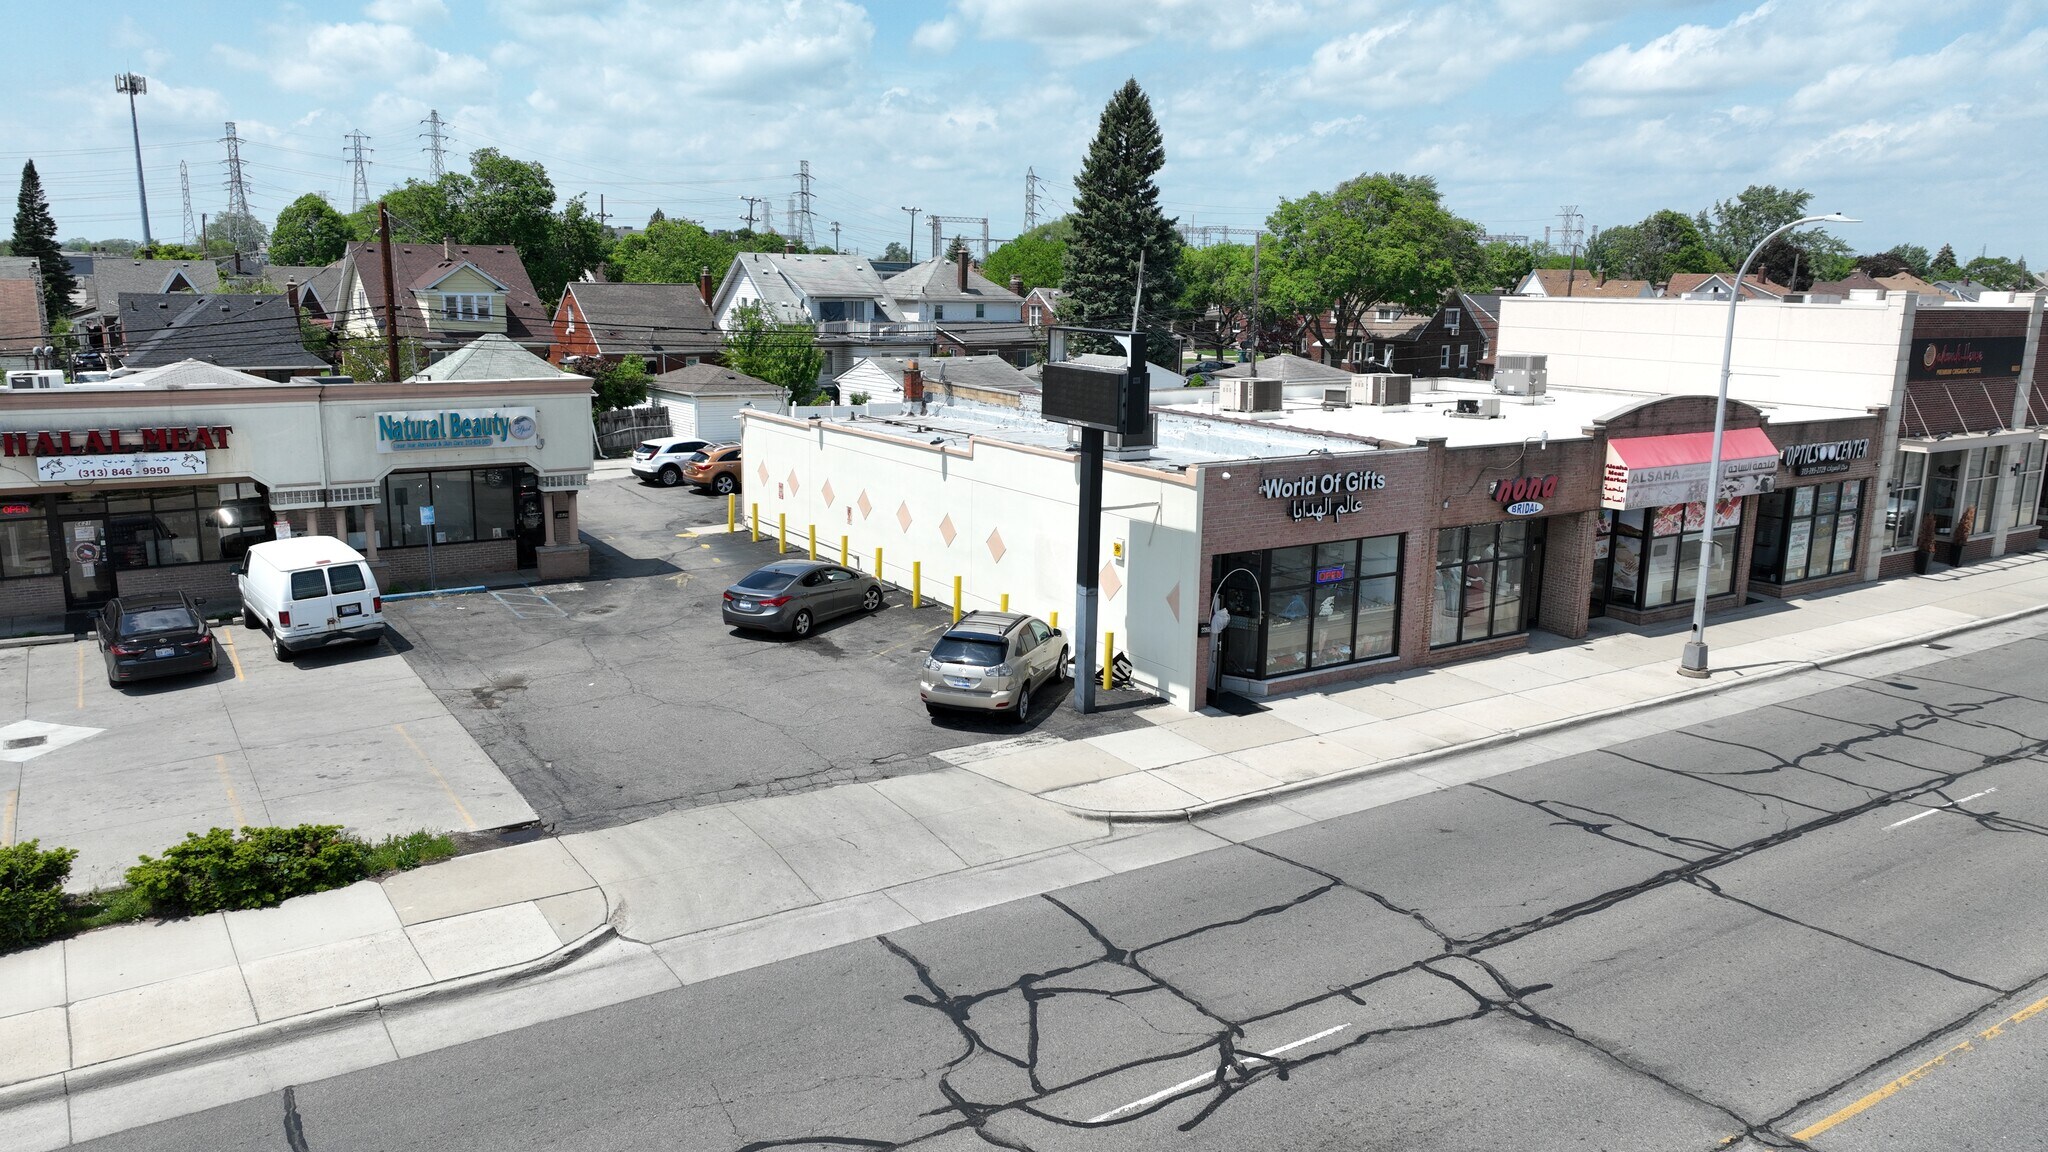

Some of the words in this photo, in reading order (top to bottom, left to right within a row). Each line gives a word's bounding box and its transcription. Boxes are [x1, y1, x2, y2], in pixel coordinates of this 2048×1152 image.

[378, 412, 447, 441] Natural
[450, 412, 510, 442] Beauty
[1, 429, 133, 457] HALAL
[140, 425, 234, 452] MEAT
[1786, 443, 1819, 466] OPTICS
[1835, 438, 1870, 461] CENTER
[79, 468, 108, 478] (313)
[111, 468, 132, 476] 846
[143, 466, 170, 475] 9950
[1264, 475, 1316, 499] World
[1320, 473, 1342, 494] Of
[1345, 471, 1386, 492] Gifts
[1631, 469, 1680, 484] ALSAHA
[1495, 474, 1559, 502] nona
[2, 505, 29, 514] OPEN
[1293, 497, 1332, 522] الهدايا
[1335, 495, 1363, 523] عالم
[1511, 503, 1539, 514] BRIDAL
[1319, 570, 1342, 581] OPEN
